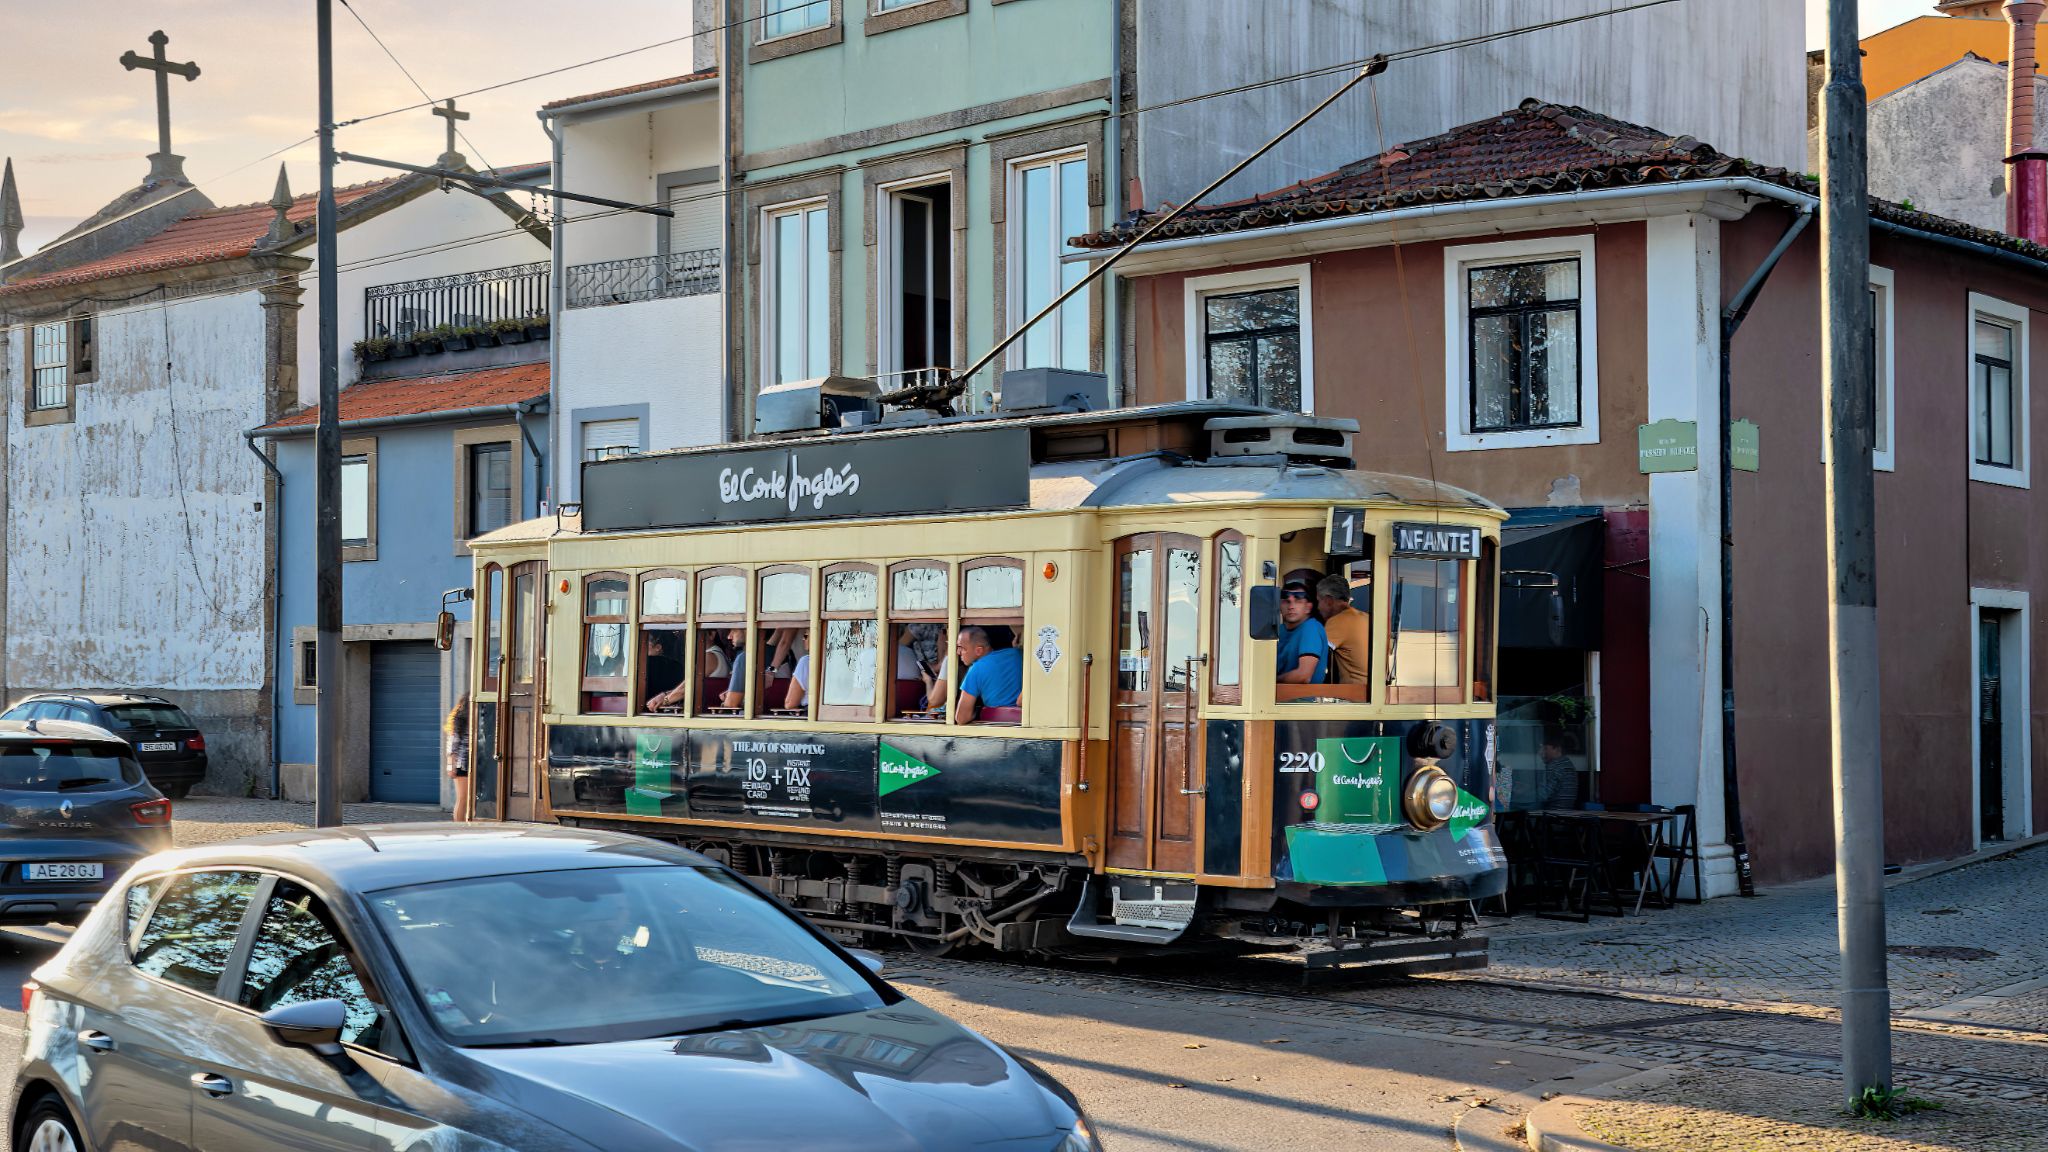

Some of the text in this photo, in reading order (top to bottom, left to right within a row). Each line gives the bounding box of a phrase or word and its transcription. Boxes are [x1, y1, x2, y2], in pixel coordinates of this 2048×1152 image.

[720, 454, 860, 512] El Corte Inglés
[1341, 514, 1354, 547] 1
[732, 741, 826, 756] THE JOY OF SHOPPING
[1279, 751, 1326, 773] 220
[783, 767, 812, 787] TAX
[746, 790, 768, 799] CARD
[36, 864, 97, 877] AE28GJ
